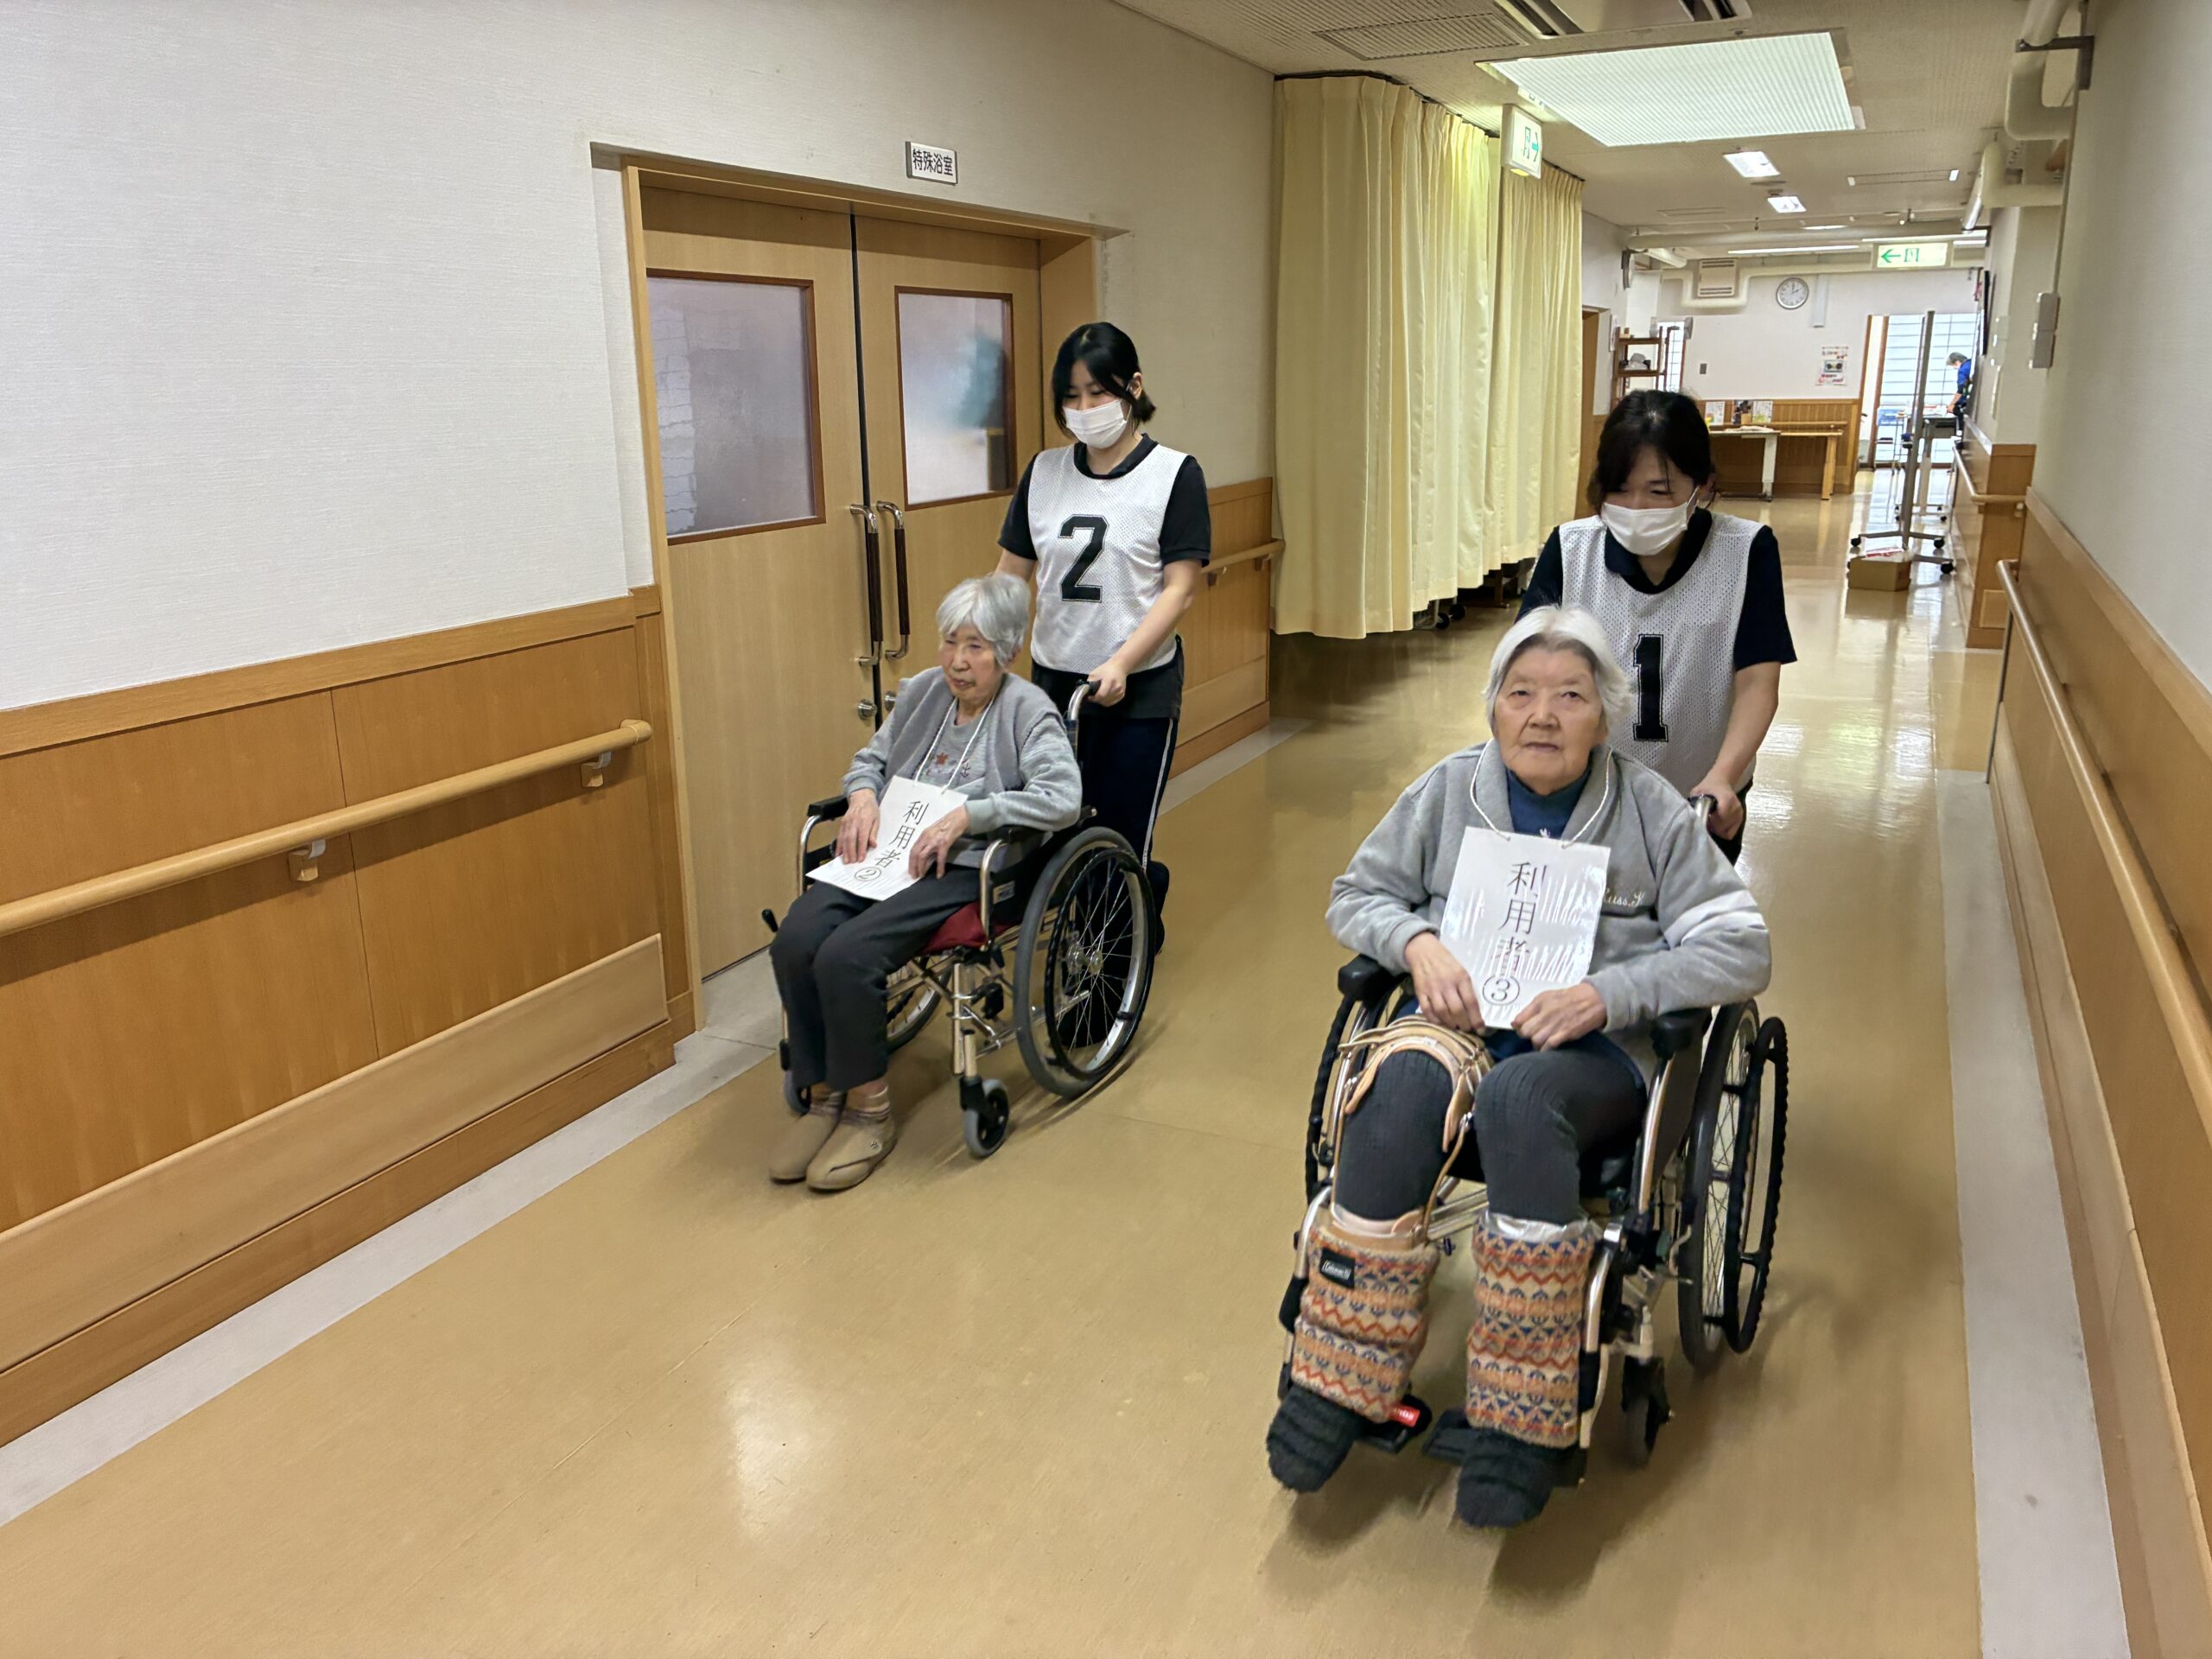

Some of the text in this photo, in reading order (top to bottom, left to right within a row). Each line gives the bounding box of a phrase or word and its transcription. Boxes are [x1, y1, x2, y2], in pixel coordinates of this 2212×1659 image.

[912, 149, 953, 176] 特殊浴室
[1058, 514, 1109, 603] 2
[1633, 633, 1669, 742] 1
